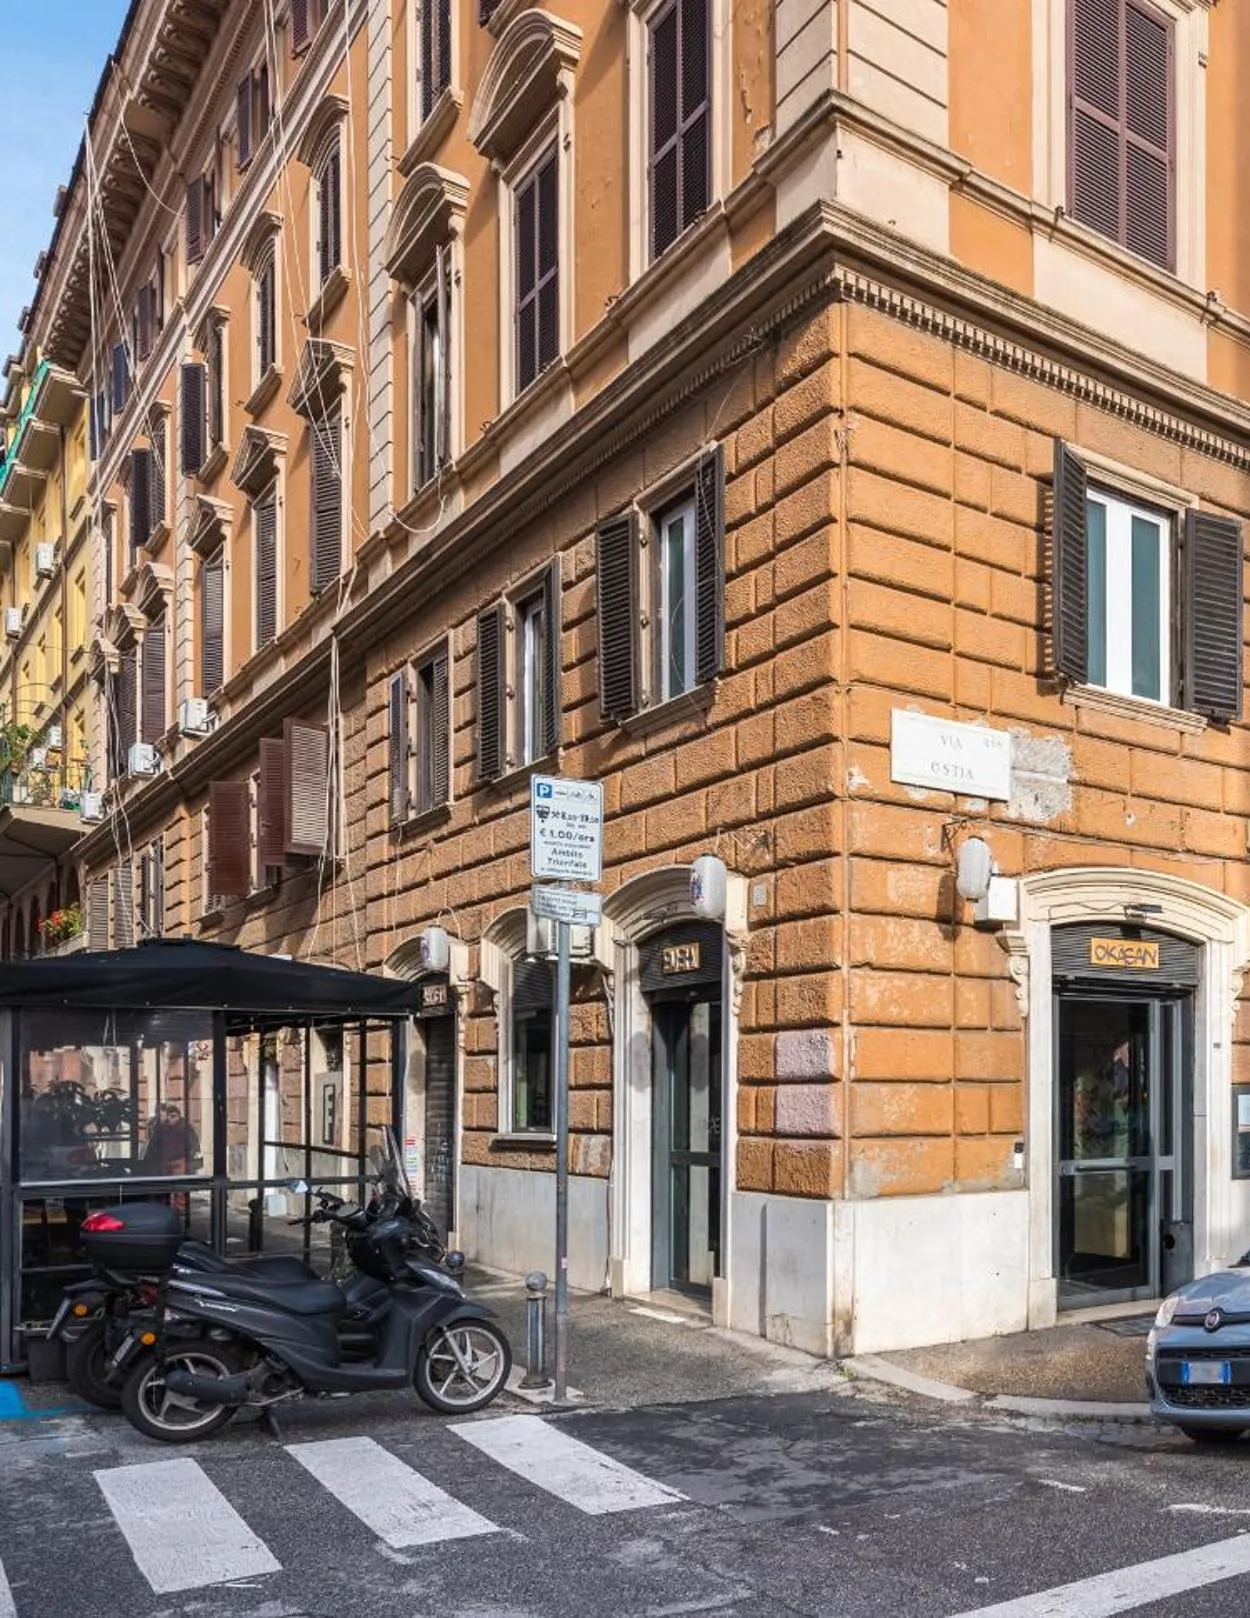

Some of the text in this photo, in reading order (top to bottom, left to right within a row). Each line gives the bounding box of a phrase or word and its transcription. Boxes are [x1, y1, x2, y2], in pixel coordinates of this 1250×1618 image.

[939, 734, 964, 750] VIA
[930, 760, 975, 780] OSTIA
[1094, 943, 1157, 966] OKASAN
